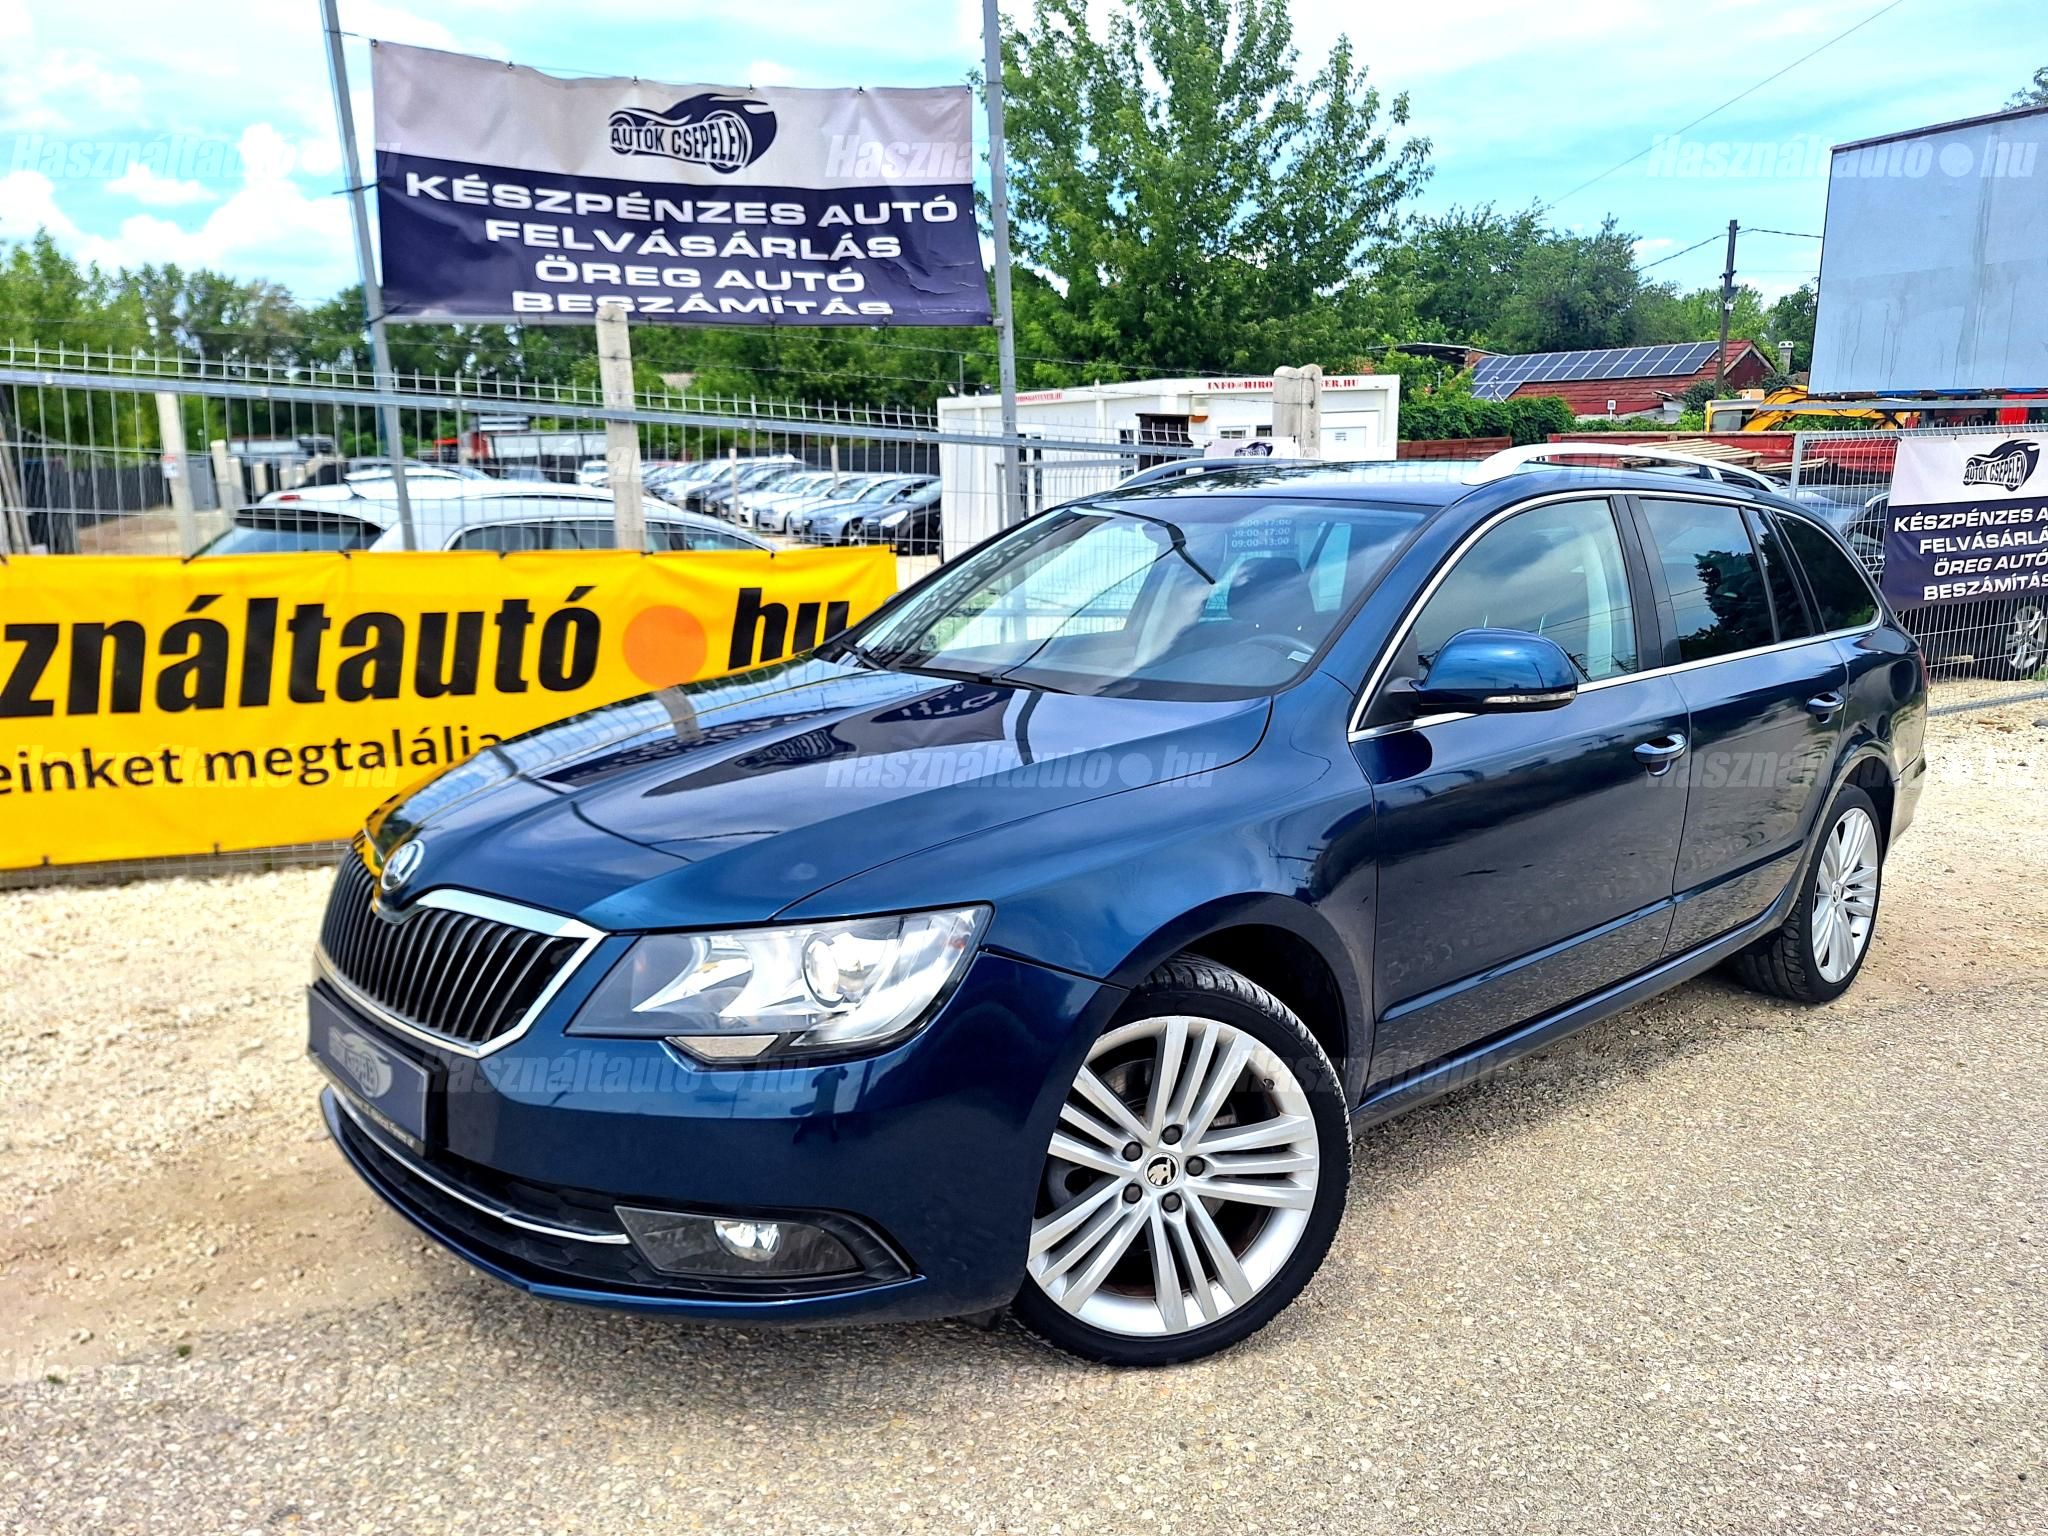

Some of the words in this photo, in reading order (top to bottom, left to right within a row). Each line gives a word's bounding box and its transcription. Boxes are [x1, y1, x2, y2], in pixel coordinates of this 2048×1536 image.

[405, 172, 806, 226] KÉSZPÉNZES
[816, 194, 959, 228] AUTÓ
[485, 219, 902, 262] FELVÁSÁRLÁS
[535, 254, 702, 288] ÖREG
[713, 266, 865, 293] AUTÓ
[512, 291, 894, 316] BESZÁMÍTÁS
[1894, 508, 2034, 533] KÉSZPÉNZES
[1933, 557, 1993, 577] ÖREG
[1993, 548, 2048, 571] AUTÓ
[0, 586, 601, 719] ználtautó
